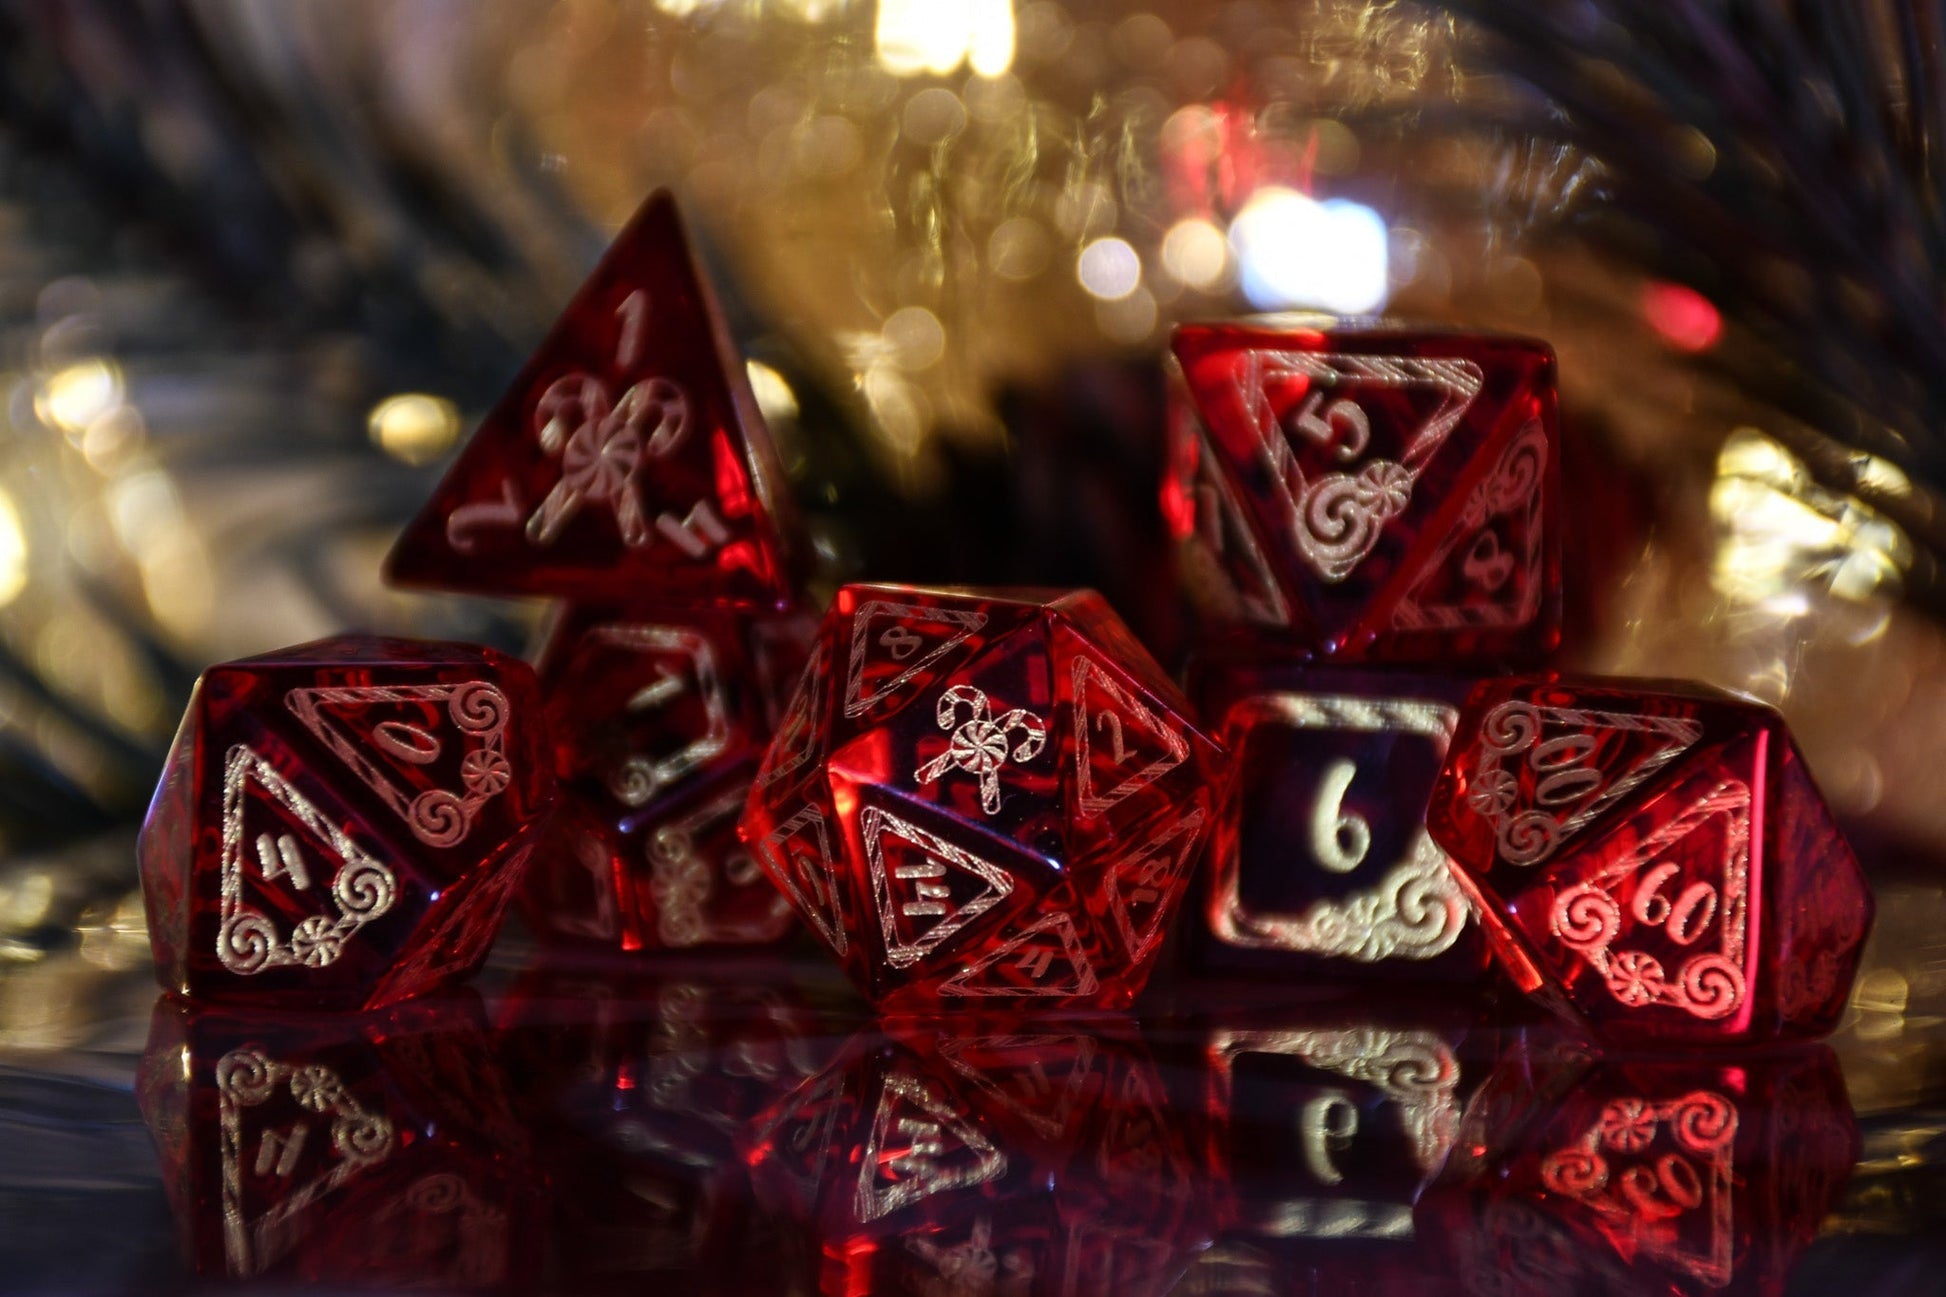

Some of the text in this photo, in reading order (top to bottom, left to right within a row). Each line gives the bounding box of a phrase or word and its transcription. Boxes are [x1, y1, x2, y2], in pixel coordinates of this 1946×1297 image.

[614, 288, 648, 370] 1
[1292, 389, 1371, 463] 5
[1463, 527, 1516, 592] 8
[878, 625, 923, 659] 8
[372, 720, 441, 764] 0
[1095, 709, 1138, 766] 2
[1528, 733, 1604, 806] 00
[1312, 756, 1372, 874] 6
[255, 831, 311, 891] 4
[894, 857, 950, 916] 14
[1631, 860, 1718, 945] 60
[1015, 949, 1054, 978] 4
